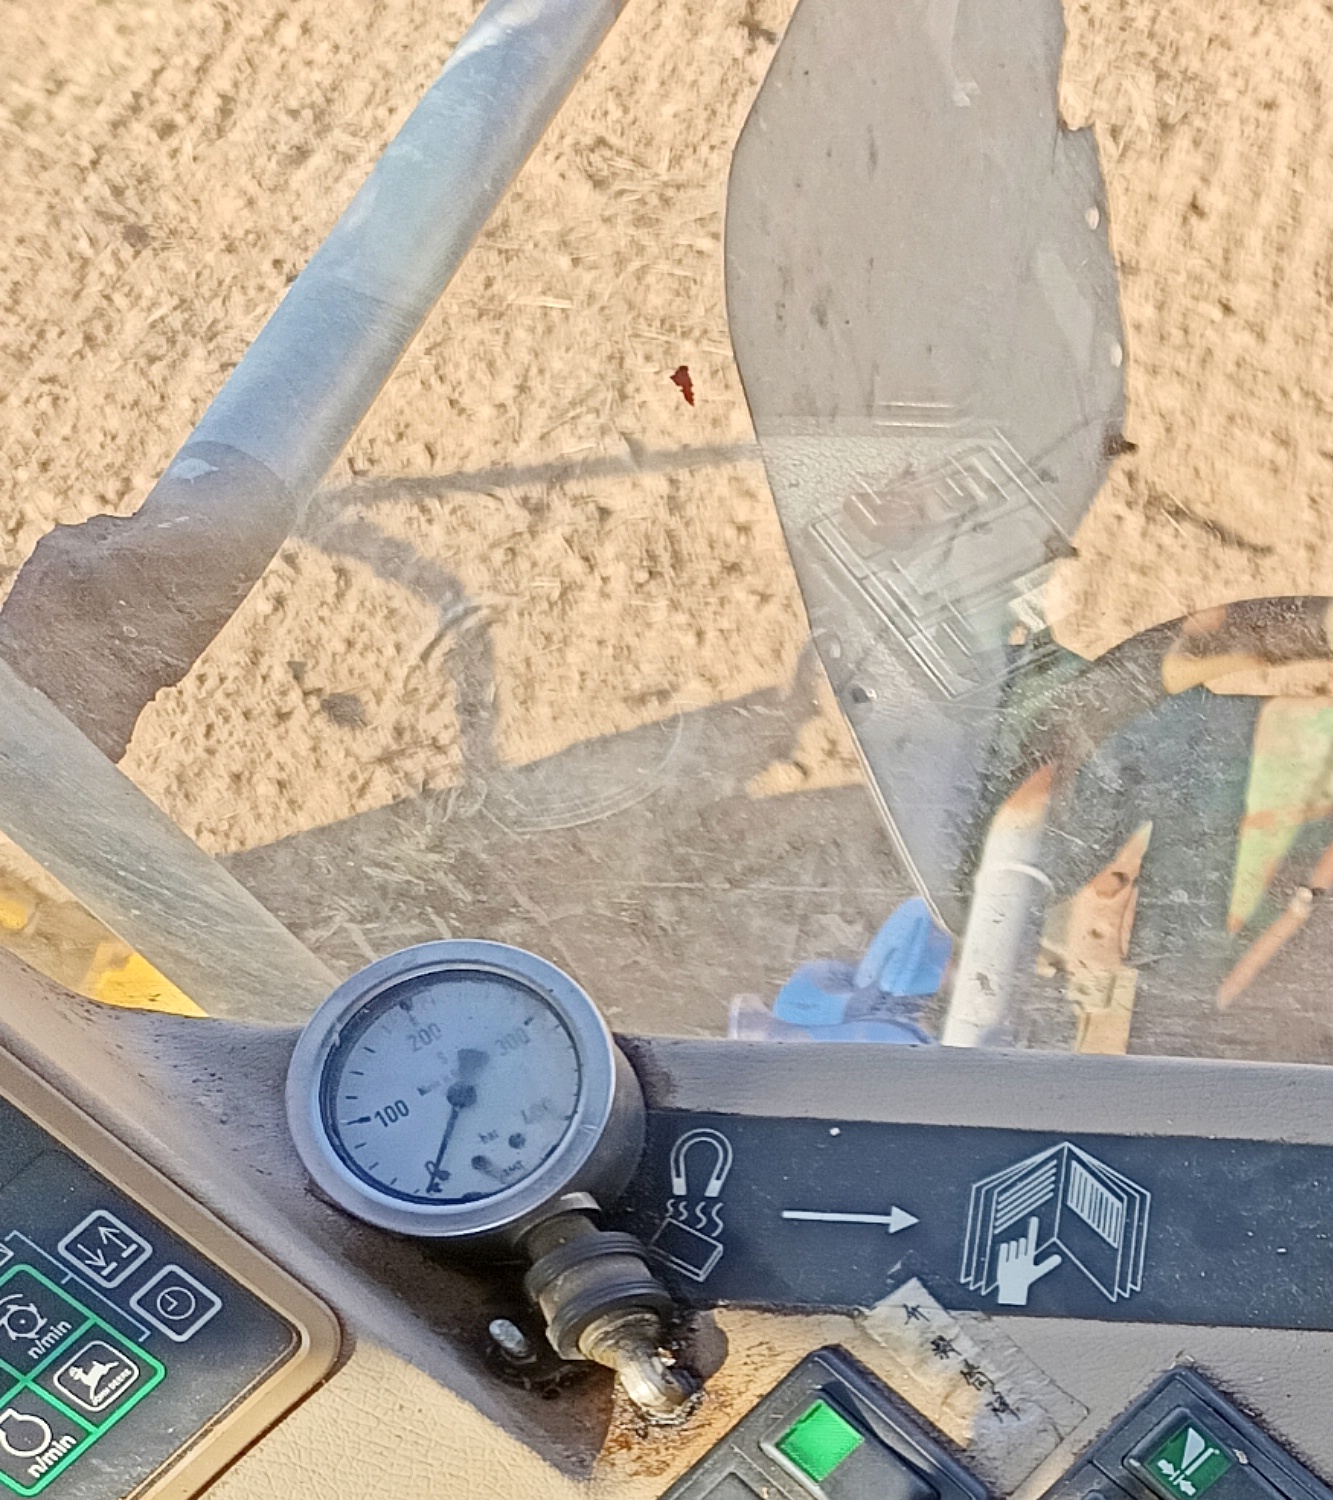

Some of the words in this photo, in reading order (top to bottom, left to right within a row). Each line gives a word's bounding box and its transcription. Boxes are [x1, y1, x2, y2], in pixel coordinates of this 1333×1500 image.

[374, 1098, 410, 1128] 100
[27, 1320, 72, 1359] n/min
[27, 1433, 76, 1478] n/min
